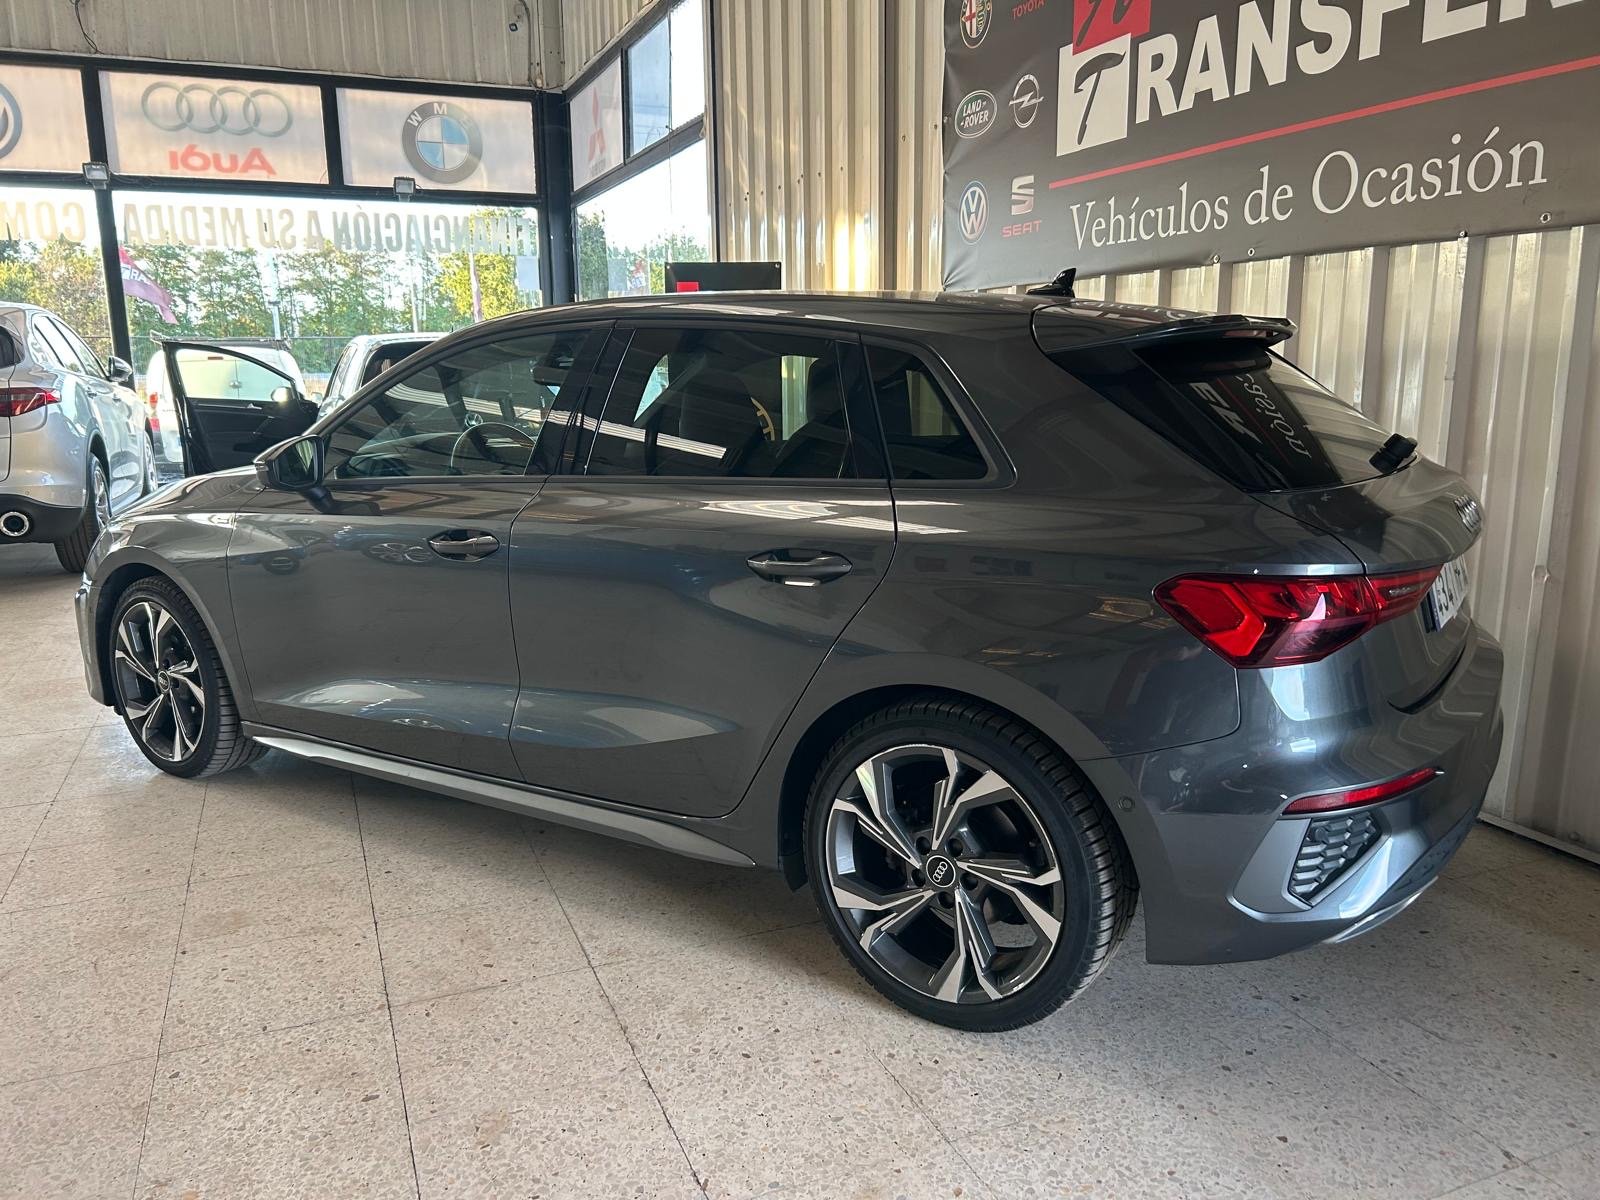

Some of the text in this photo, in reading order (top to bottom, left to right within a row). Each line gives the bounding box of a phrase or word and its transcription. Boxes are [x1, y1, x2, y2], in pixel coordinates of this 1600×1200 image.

[1011, 0, 1047, 20] TOYOTA
[962, 98, 982, 117] LAND
[963, 110, 990, 129] ROVER
[1070, 126, 1548, 250] Vehículos de Ocasión
[1001, 219, 1042, 238] SEAT
